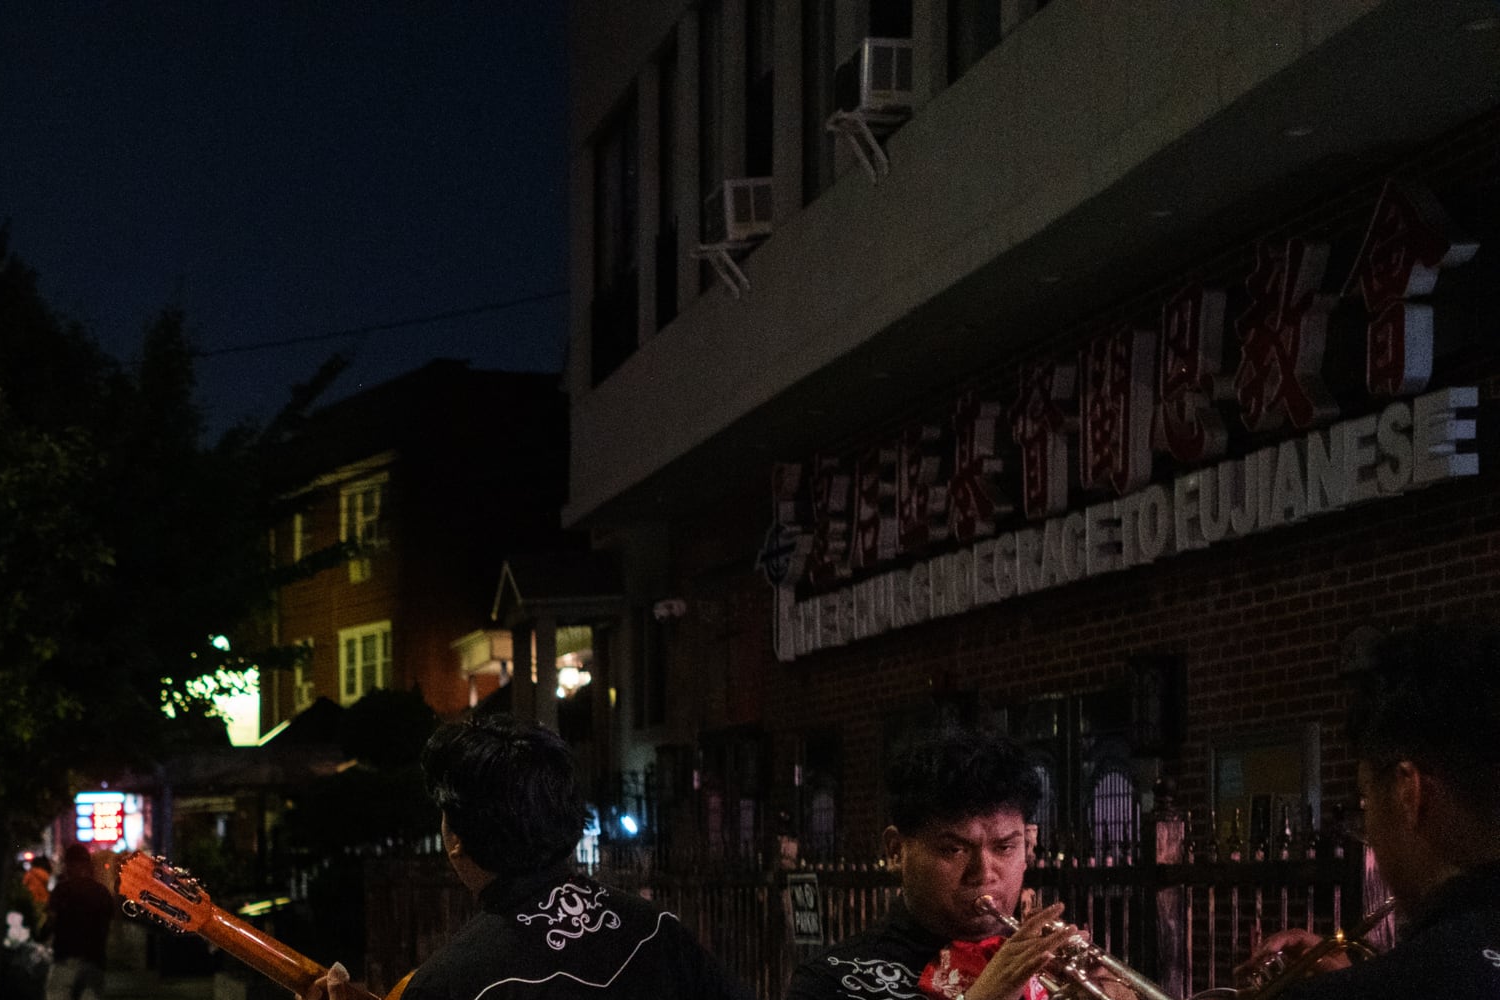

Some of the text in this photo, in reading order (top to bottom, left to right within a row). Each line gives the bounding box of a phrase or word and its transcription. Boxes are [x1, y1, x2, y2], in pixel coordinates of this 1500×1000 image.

[994, 500, 1122, 602] GRACE
[1114, 483, 1174, 568] TO
[1174, 386, 1480, 554] FUJIANESE
